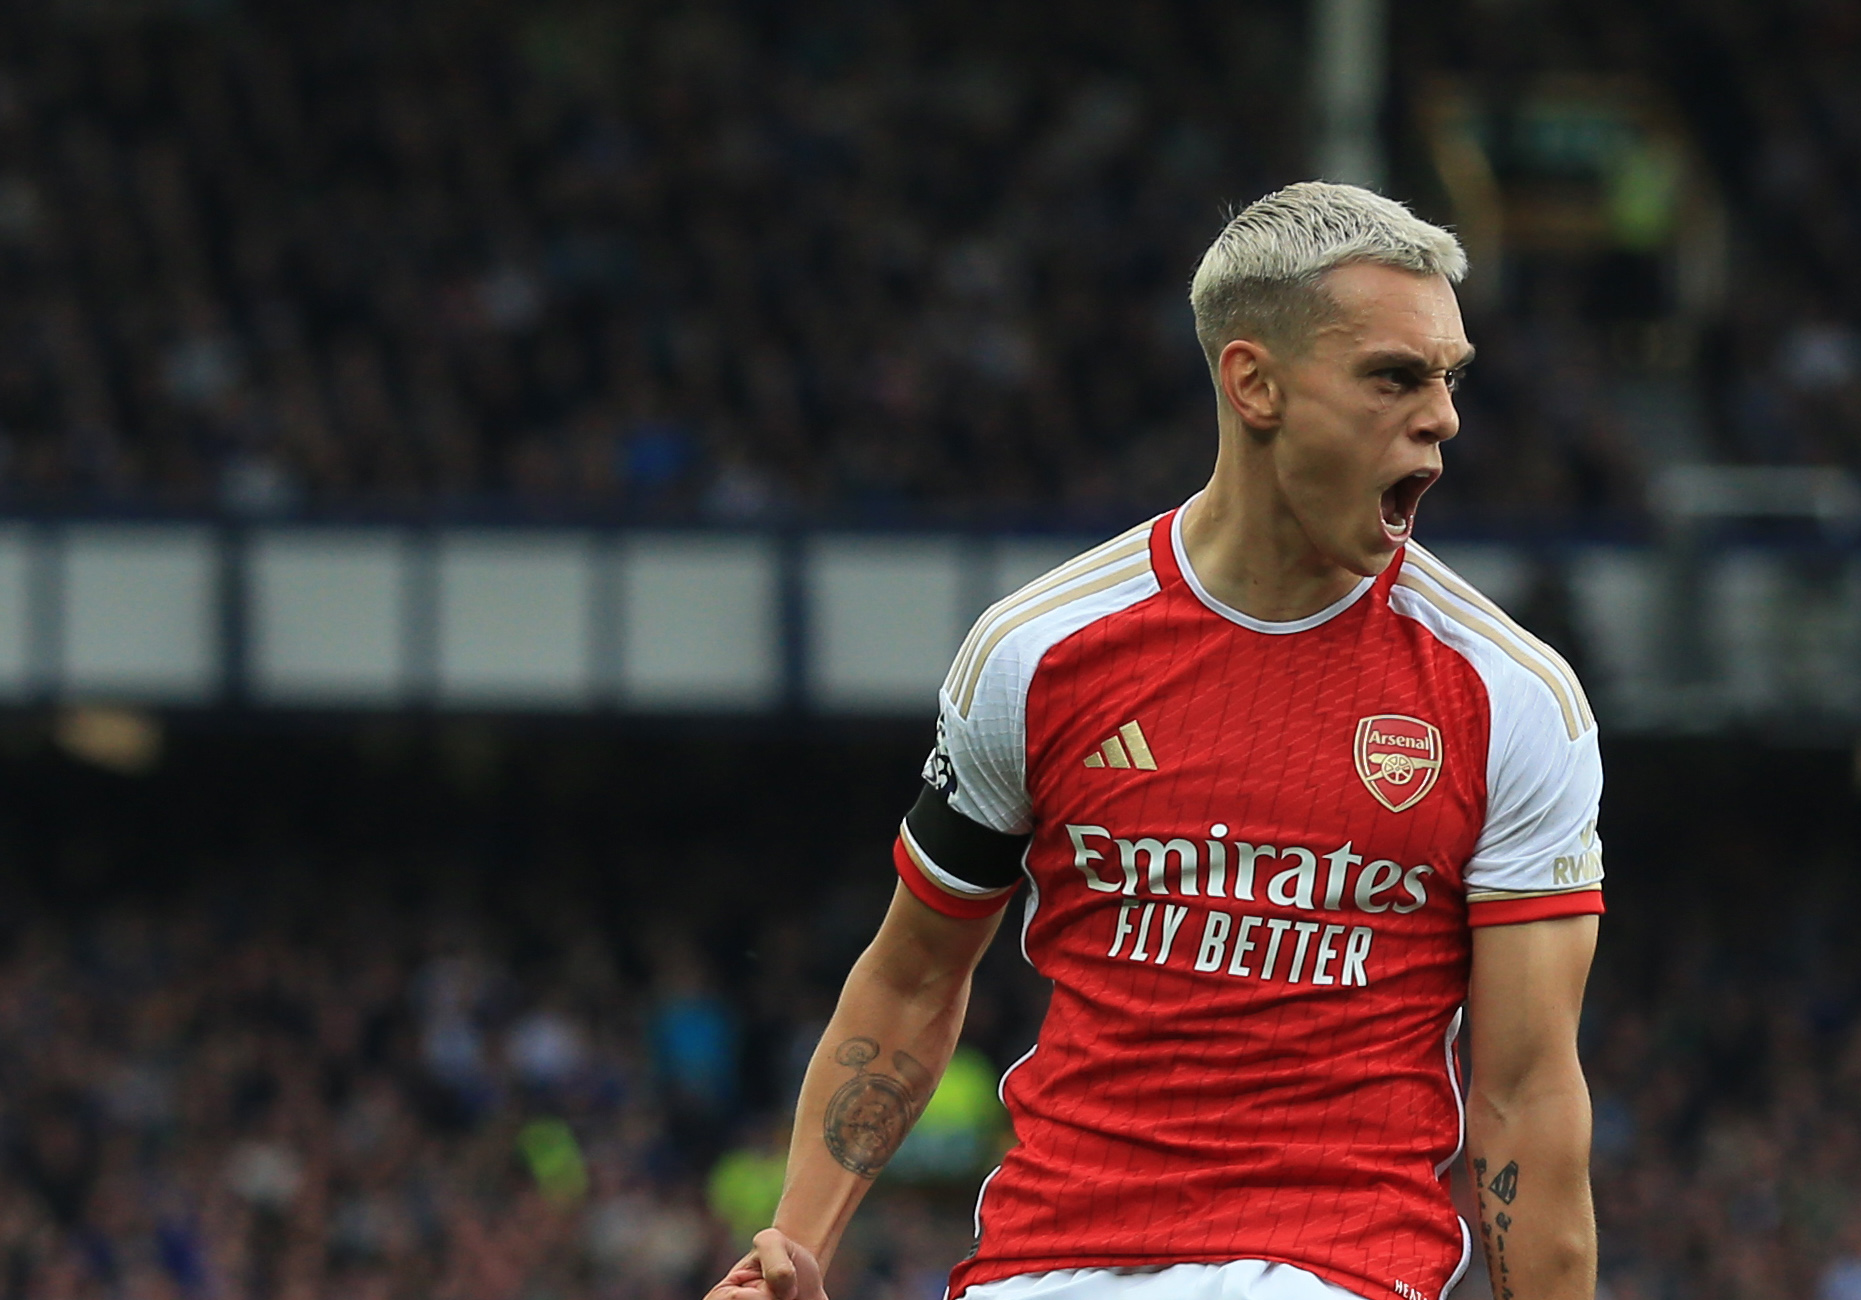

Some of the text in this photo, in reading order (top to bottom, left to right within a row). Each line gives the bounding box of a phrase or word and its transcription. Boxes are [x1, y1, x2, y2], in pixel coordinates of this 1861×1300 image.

[1368, 730, 1429, 751] Arsenal
[1065, 822, 1435, 914] Emirates
[1106, 899, 1374, 988] FLY BETTER
